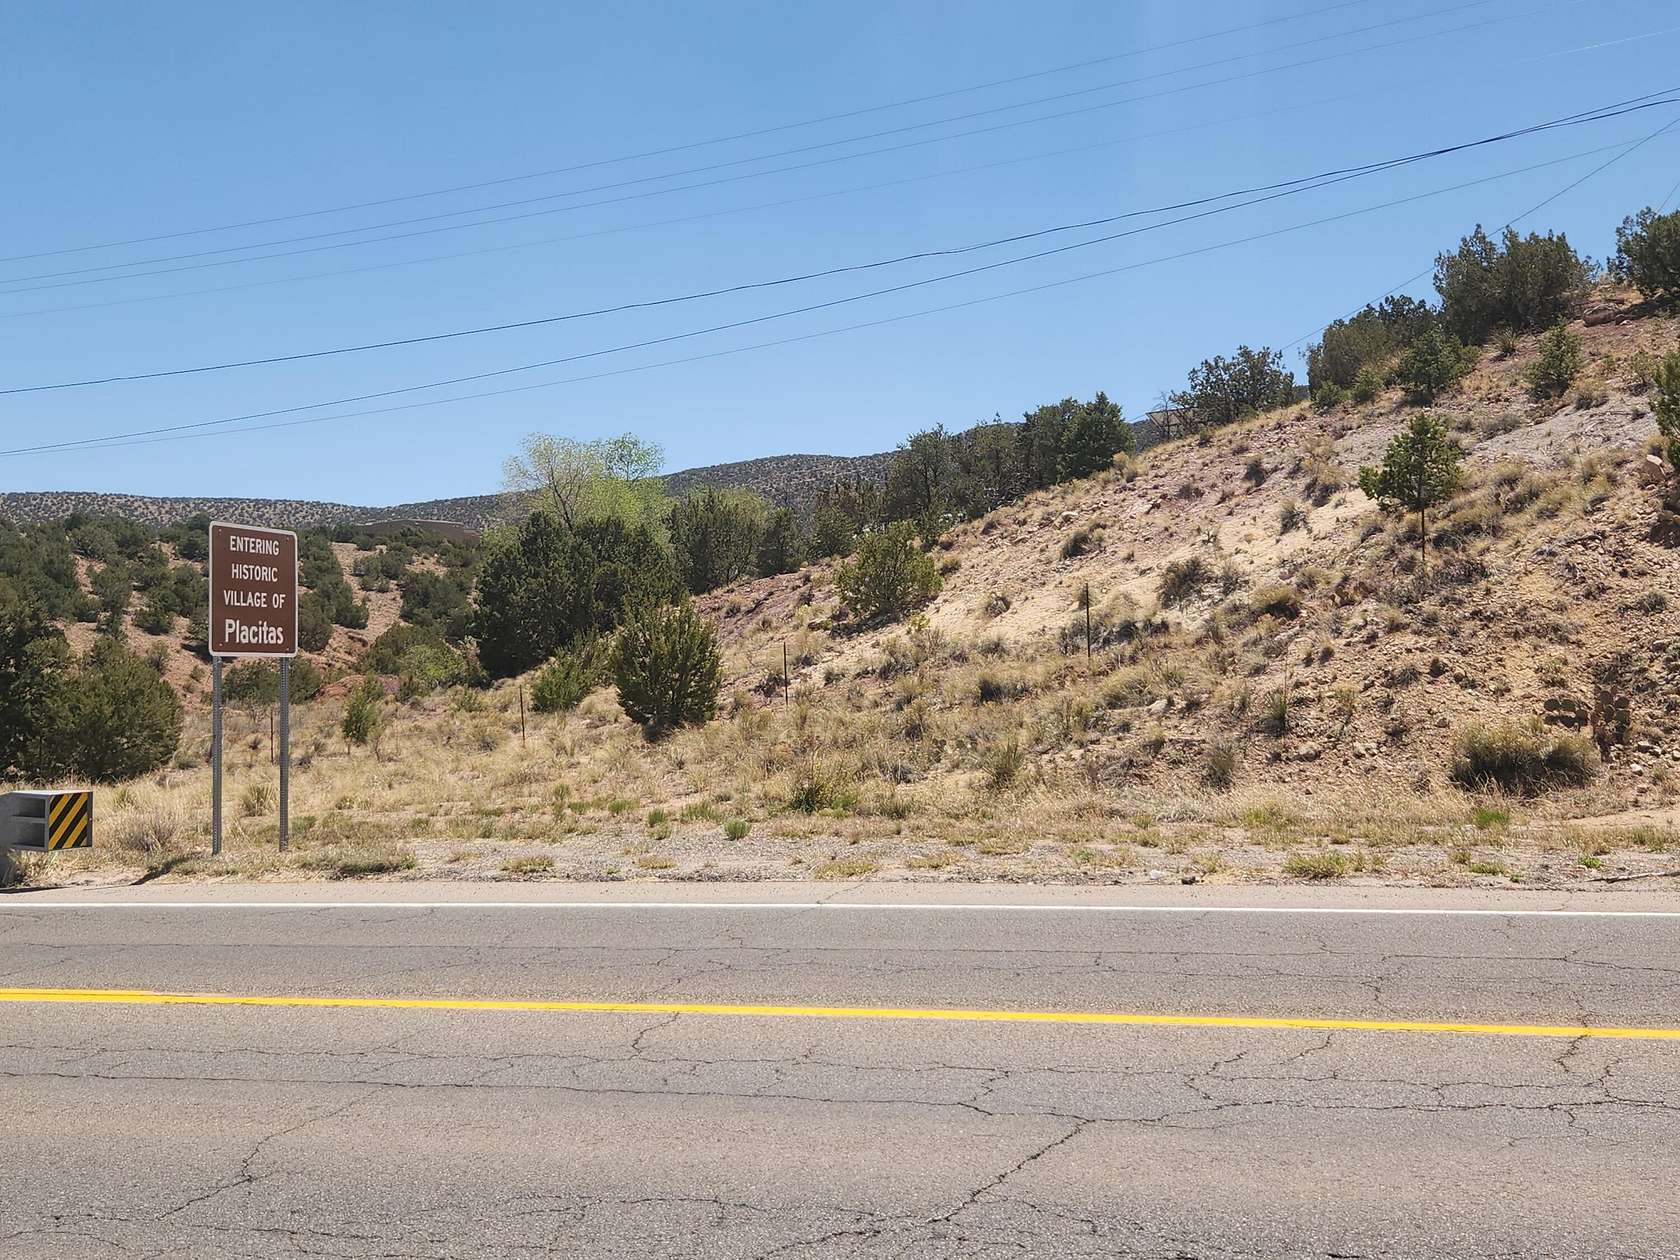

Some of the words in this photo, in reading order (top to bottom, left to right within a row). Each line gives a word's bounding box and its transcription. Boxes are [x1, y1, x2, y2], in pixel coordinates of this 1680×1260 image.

[229, 535, 280, 556] ENTERING
[231, 563, 278, 583] HISTORIC
[223, 589, 268, 608] VILLAGE
[272, 593, 286, 609] OF
[225, 618, 284, 645] Placitas
